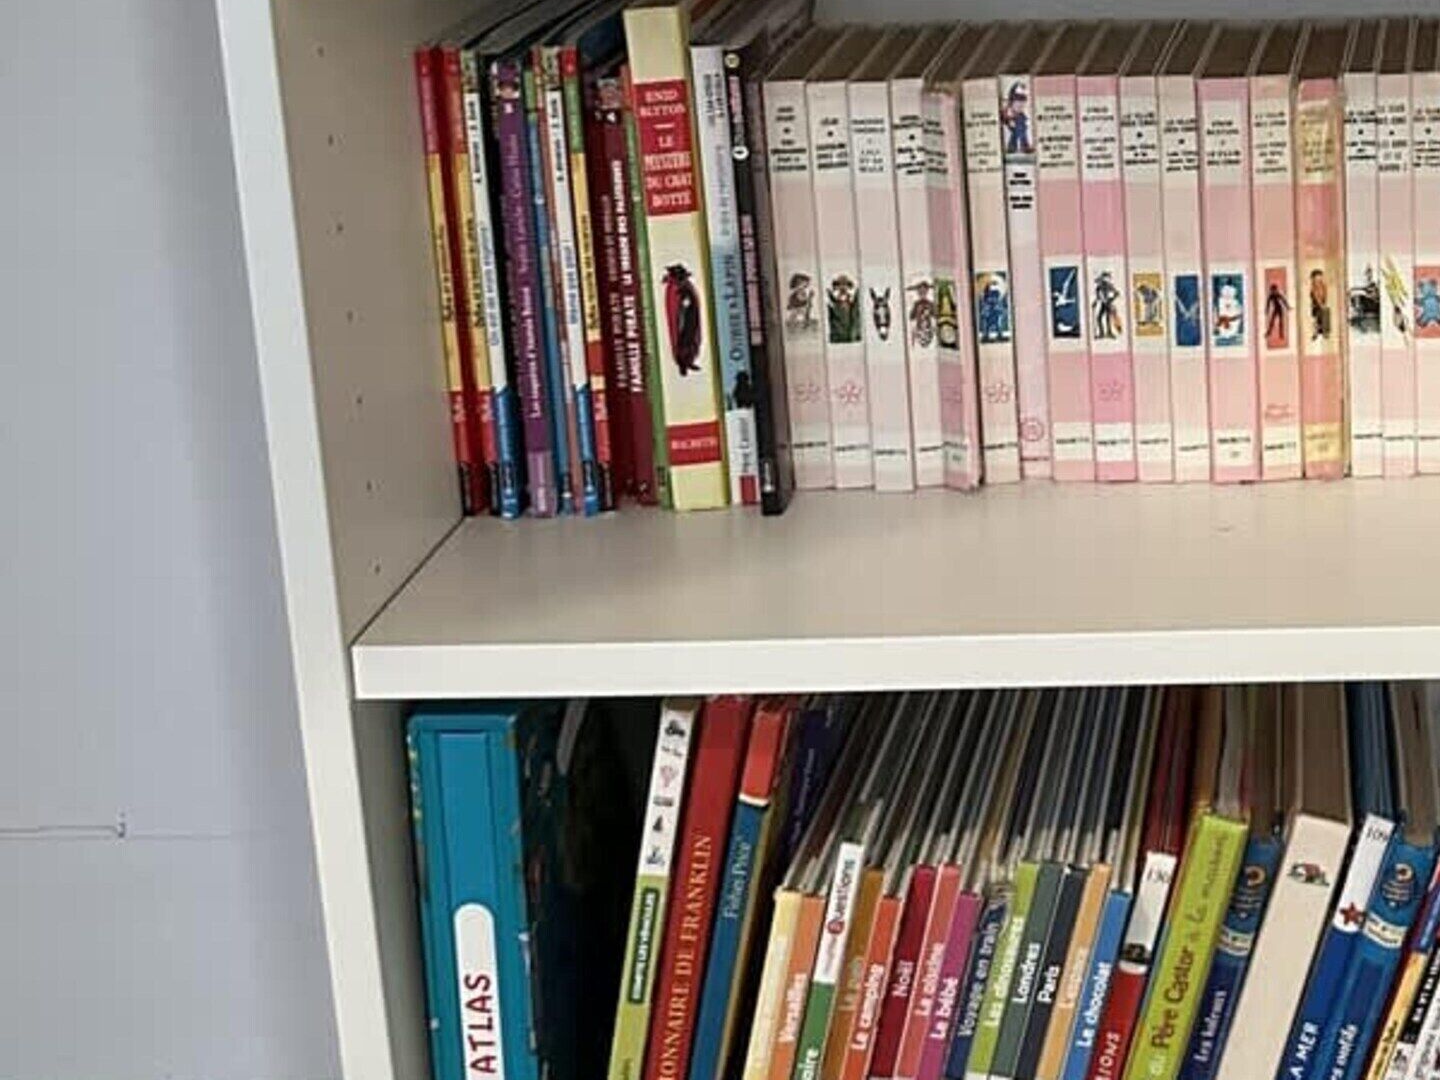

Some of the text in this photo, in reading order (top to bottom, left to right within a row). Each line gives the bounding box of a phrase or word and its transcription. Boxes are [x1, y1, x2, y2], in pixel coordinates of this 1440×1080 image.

[658, 135, 675, 147] LE
[624, 296, 643, 392] FAMILLE PIRATE
[675, 834, 712, 974] DE FRANKLIN
[779, 972, 807, 1043] Versailles
[851, 963, 884, 1050] Le camping
[892, 959, 913, 997] Noël
[914, 943, 945, 1016] La piscine
[929, 978, 957, 1040] Le bébé
[957, 922, 999, 1037] Voyage en train
[1012, 942, 1041, 1004] Londres
[1037, 964, 1060, 1003] Paris
[1076, 961, 1111, 1047] Le chocolat
[1151, 947, 1193, 1049] Père Castor
[464, 973, 497, 1074] ATLAS
[1294, 1021, 1320, 1061] MER
